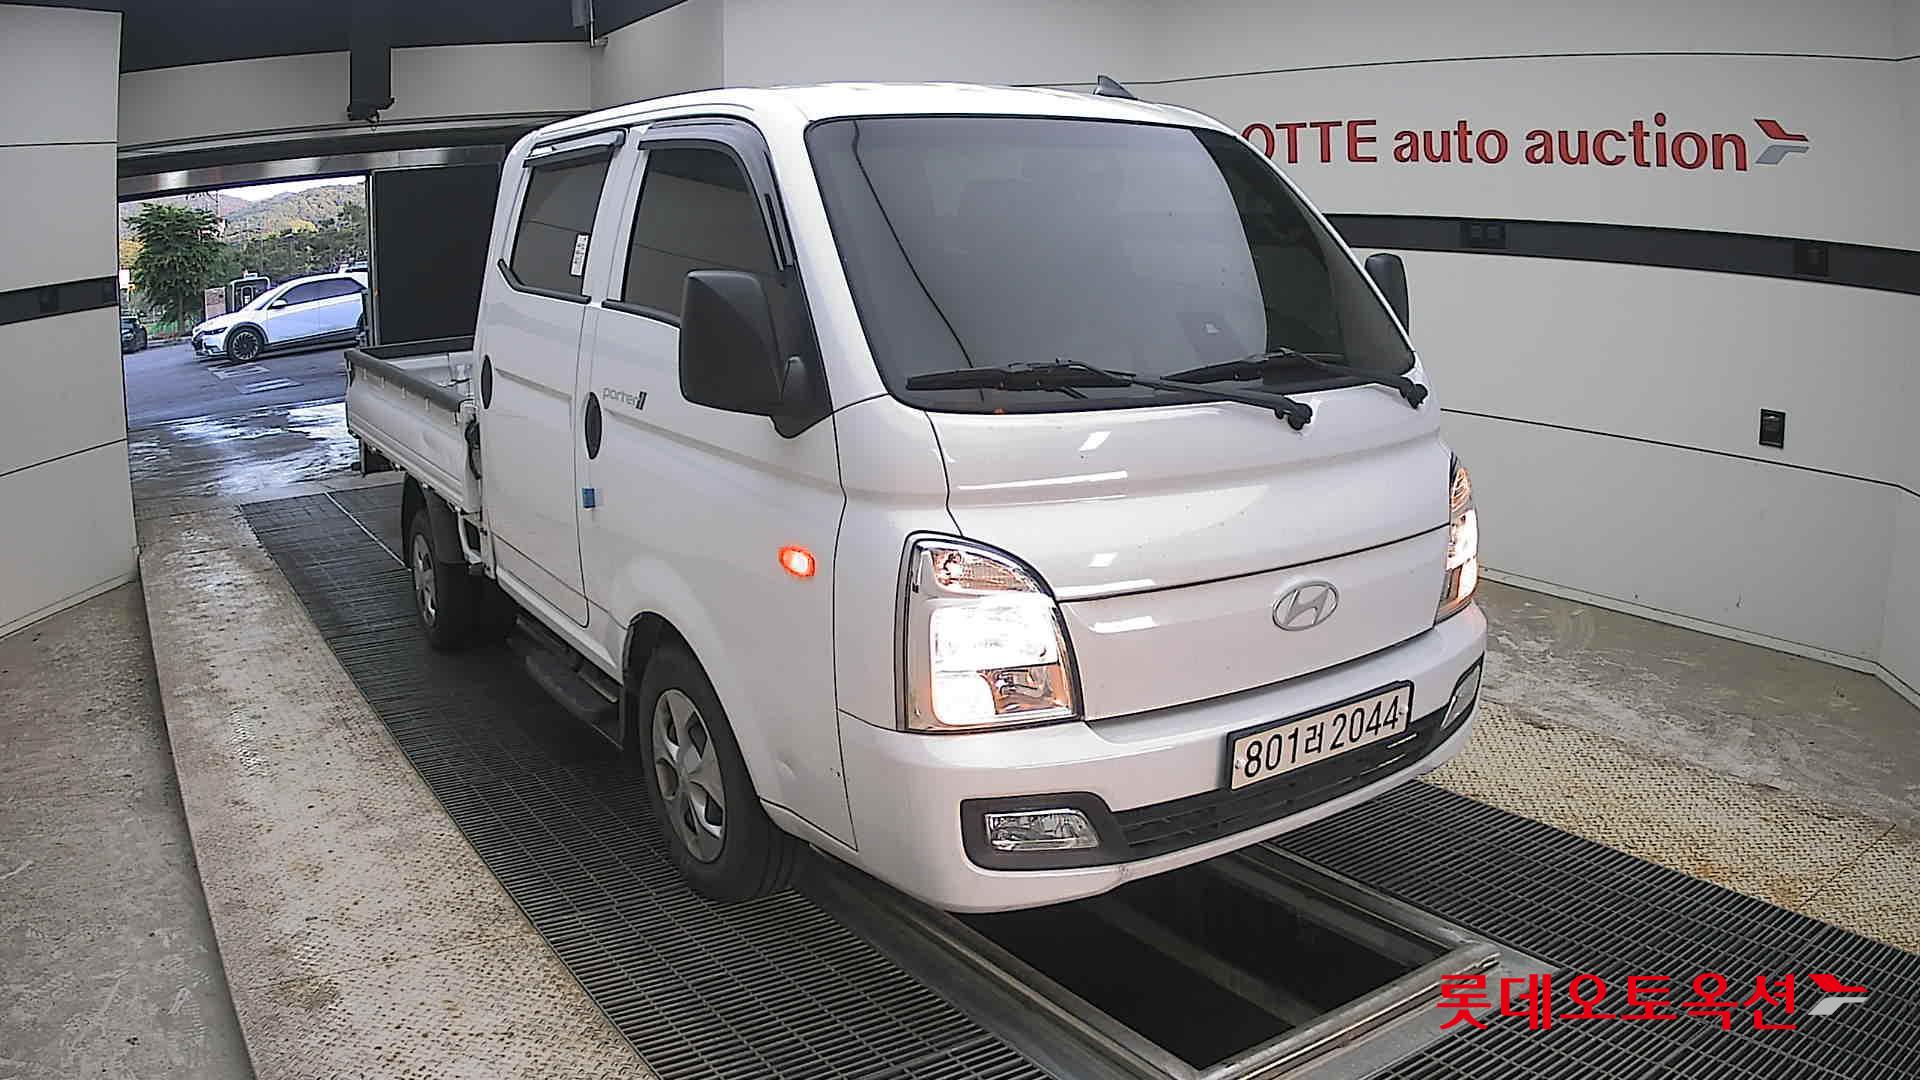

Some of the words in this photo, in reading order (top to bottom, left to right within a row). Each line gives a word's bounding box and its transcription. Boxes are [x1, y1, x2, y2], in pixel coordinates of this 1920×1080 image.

[1241, 119, 1378, 164] OTTE
[1393, 120, 1510, 164] auto
[1525, 112, 1749, 171] auction
